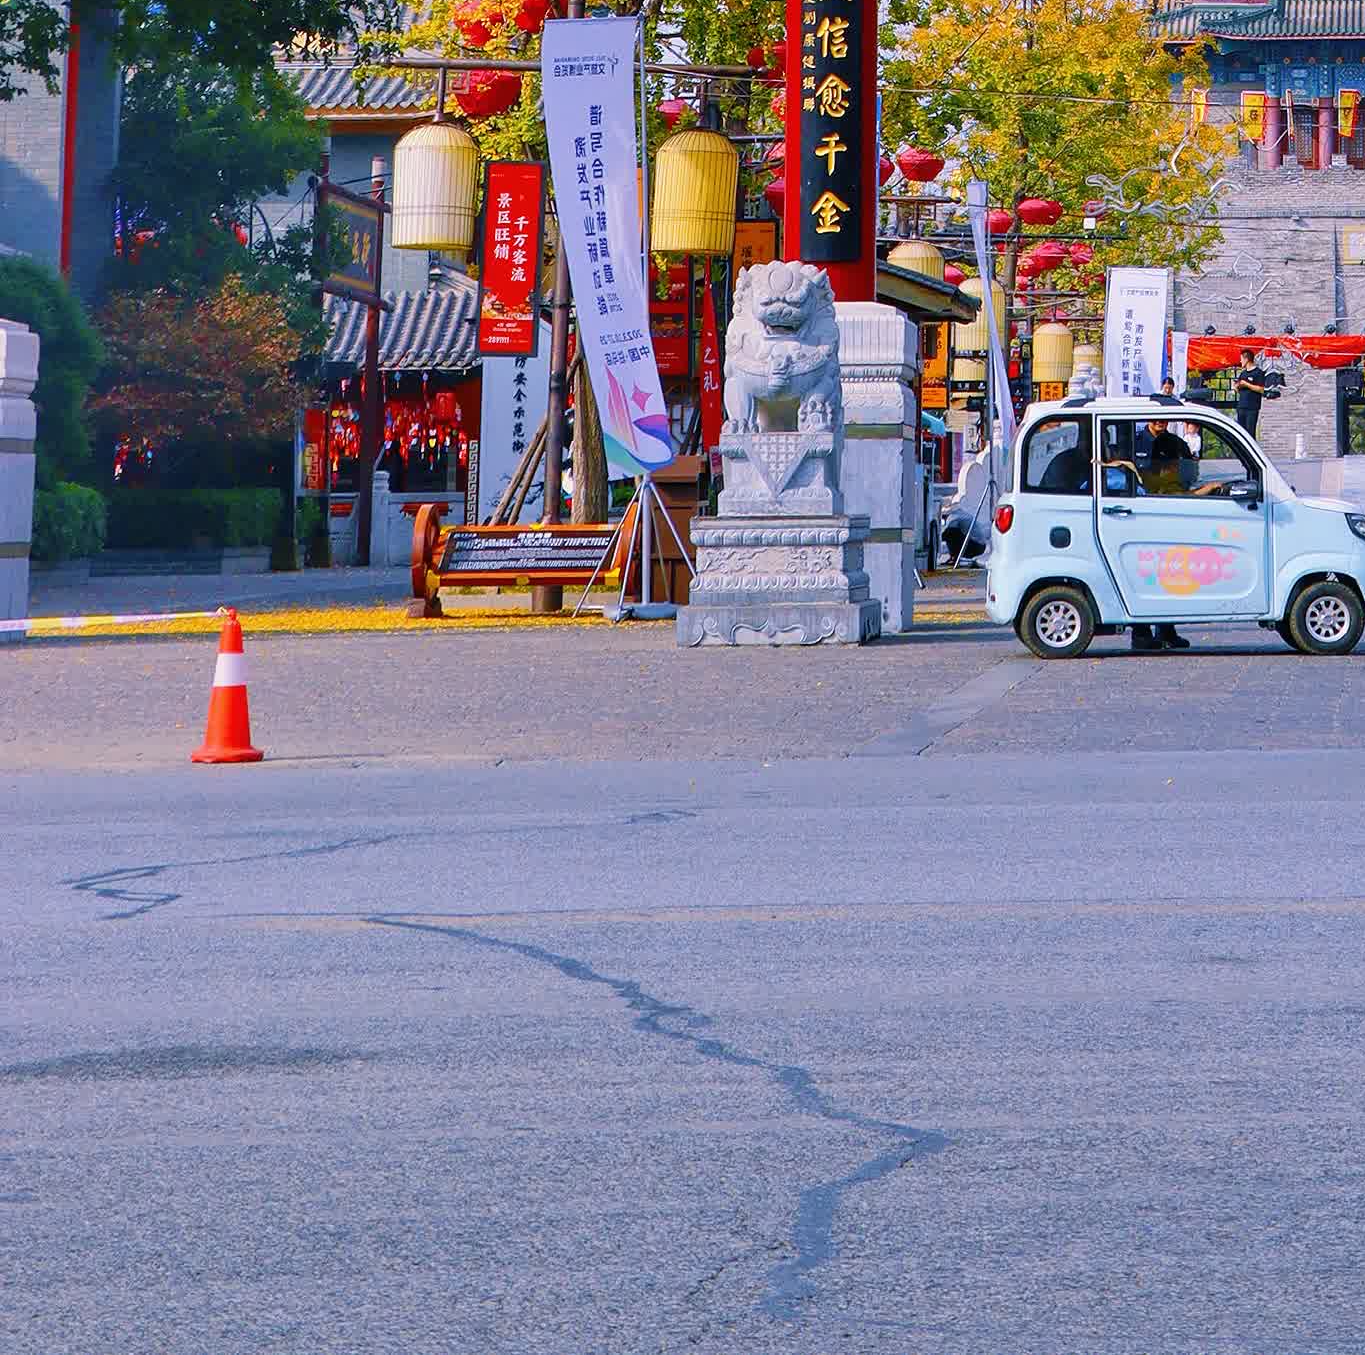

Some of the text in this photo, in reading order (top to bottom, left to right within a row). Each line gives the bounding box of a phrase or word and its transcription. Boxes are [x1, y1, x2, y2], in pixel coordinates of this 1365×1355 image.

[493, 192, 513, 261] 景区旺铺
[510, 215, 529, 282] 千万客流
